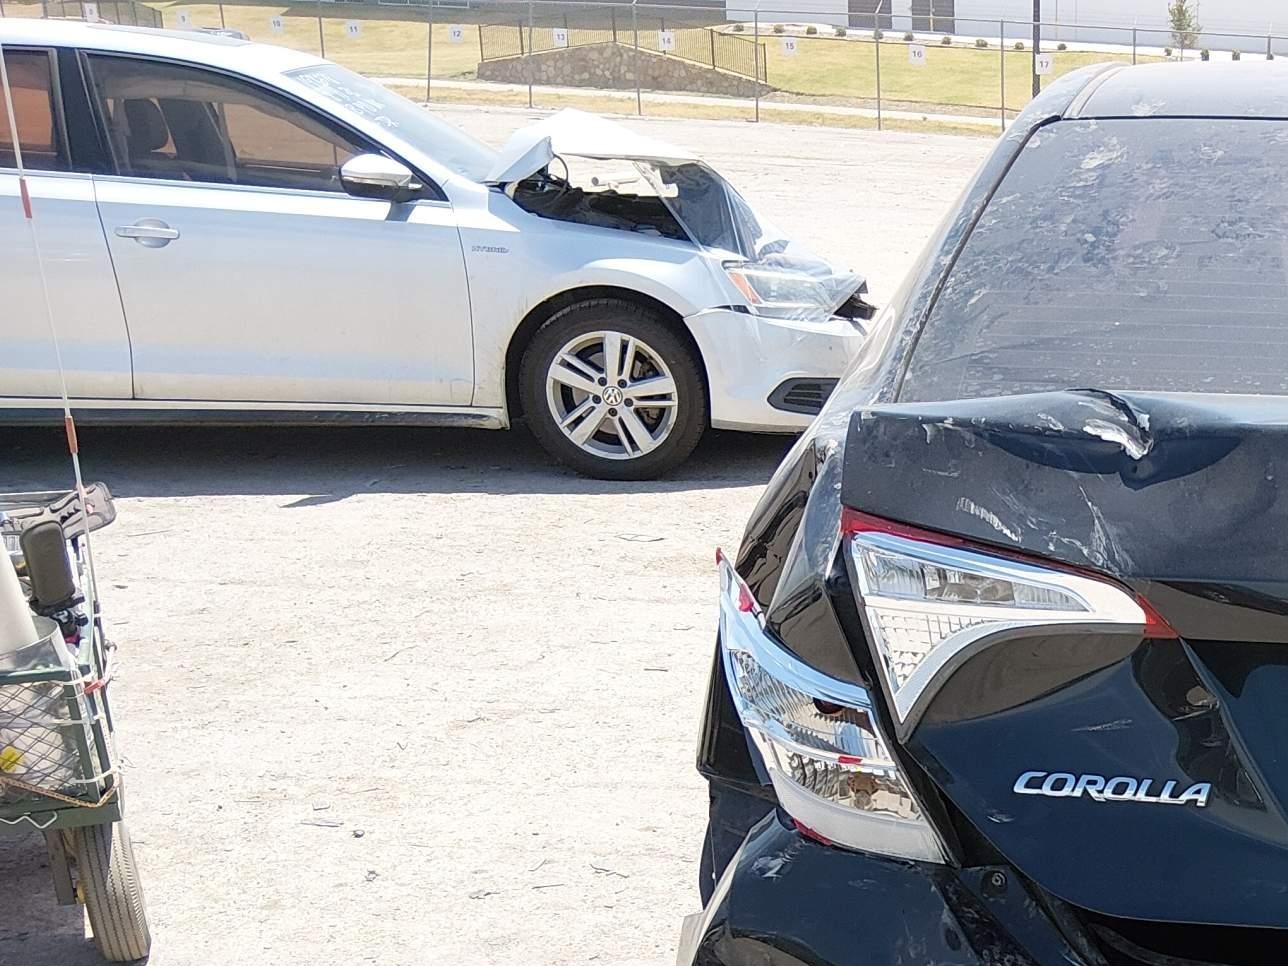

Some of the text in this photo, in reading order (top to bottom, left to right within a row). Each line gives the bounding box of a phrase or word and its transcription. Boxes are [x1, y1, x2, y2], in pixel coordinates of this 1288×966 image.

[348, 25, 358, 33] 11
[452, 29, 462, 38] 12
[556, 33, 566, 42] 13
[661, 37, 672, 46] 14
[784, 41, 795, 51] 15
[911, 50, 923, 59] 16
[1038, 60, 1050, 69] 17
[1012, 770, 1212, 808] COROLLA
